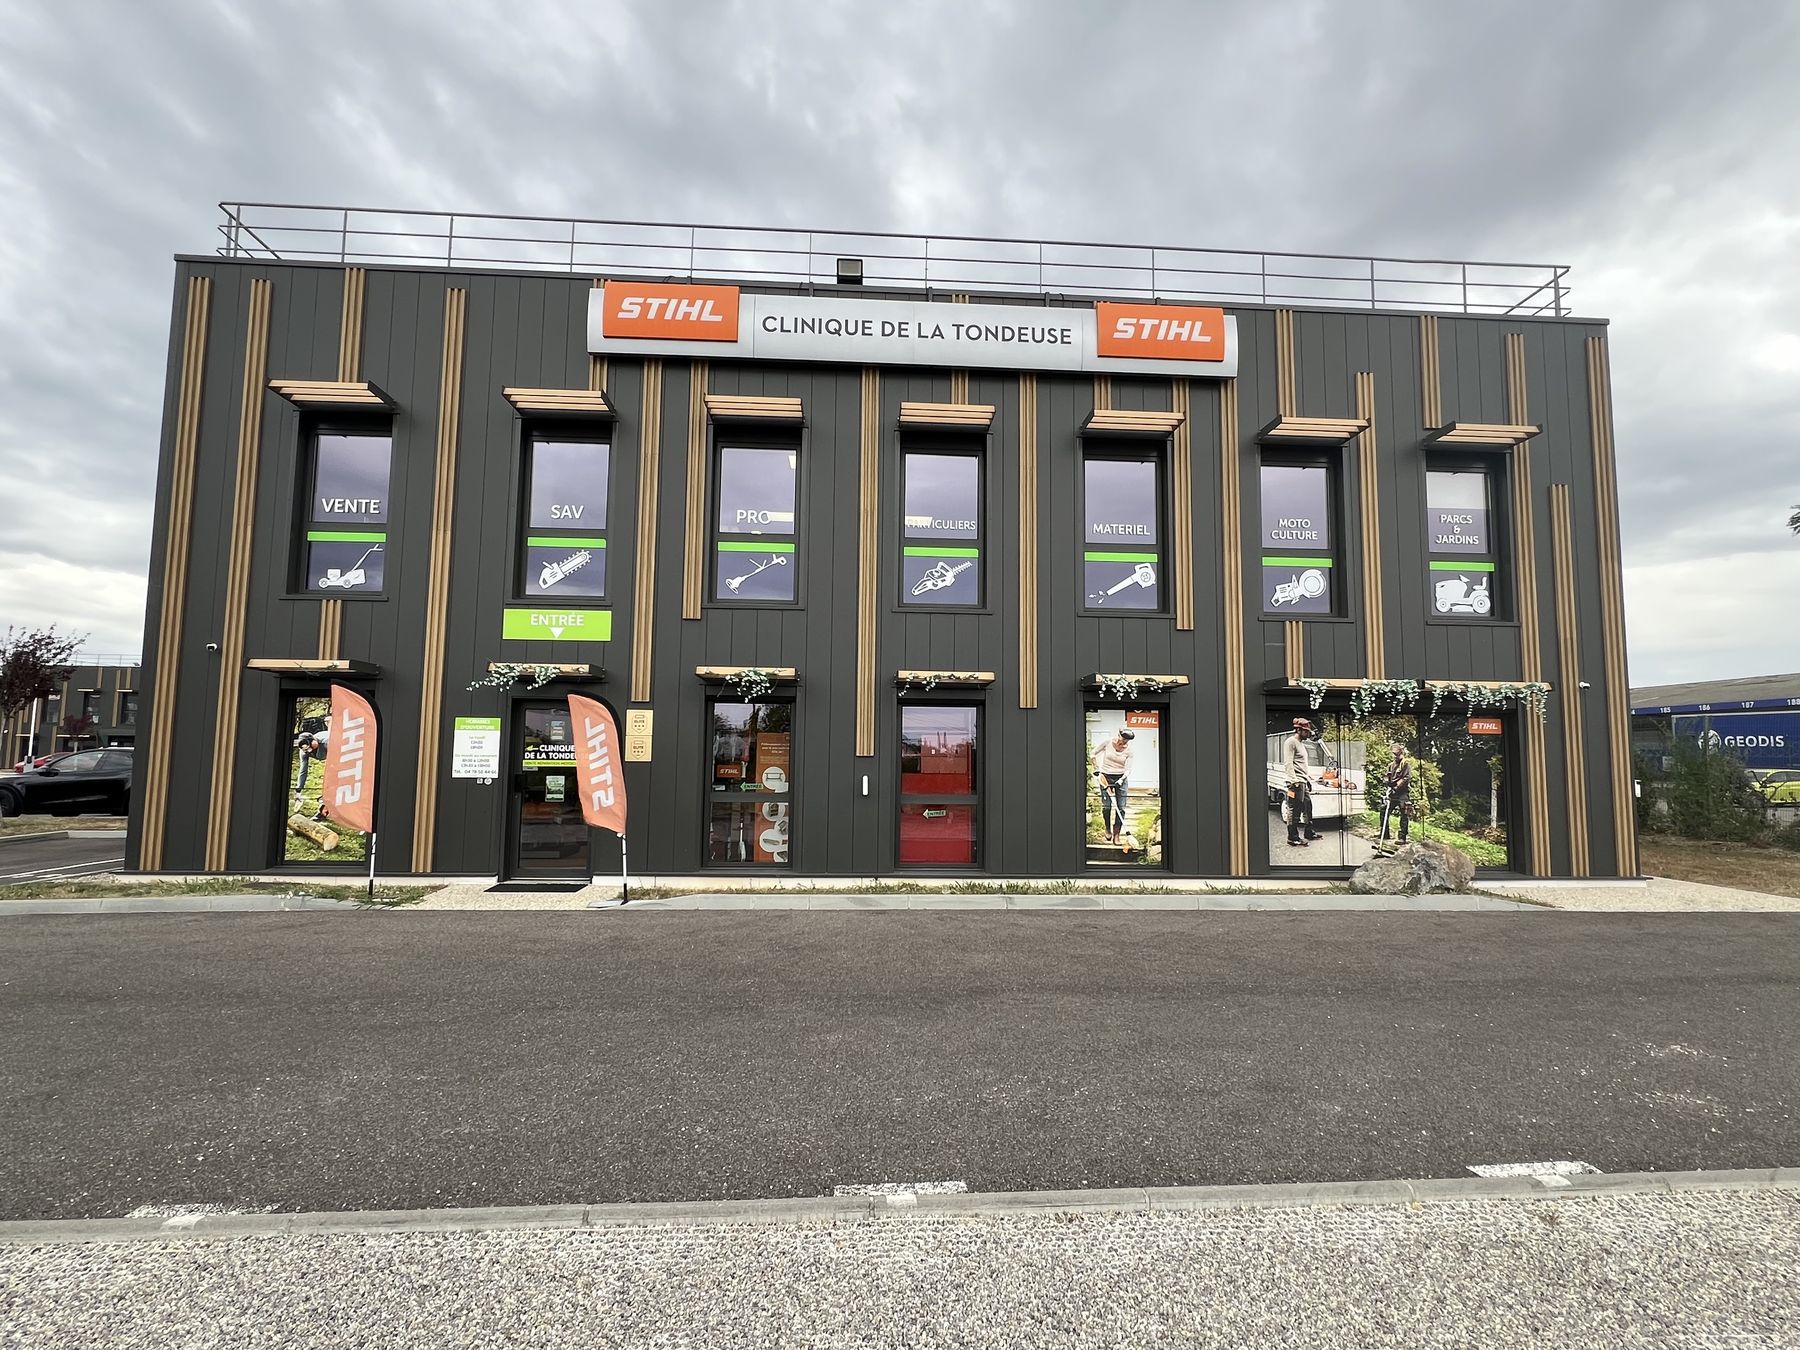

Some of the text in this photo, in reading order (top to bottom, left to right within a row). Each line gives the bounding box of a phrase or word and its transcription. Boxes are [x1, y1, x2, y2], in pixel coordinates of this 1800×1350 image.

[617, 297, 723, 322] STIHL
[762, 316, 1072, 345] CLINIQUE DE LA TONDEUSE
[1113, 317, 1212, 342] STIHL
[321, 498, 380, 514] VENTE
[550, 504, 584, 519] SAV
[736, 509, 772, 525] PRO
[1440, 514, 1473, 524] PARCS
[1279, 518, 1311, 528] MOTO
[1093, 523, 1151, 535] MATERIEL
[1453, 525, 1461, 534] &
[1271, 530, 1318, 540] CULTURE
[1435, 535, 1480, 545] JARDINS
[530, 611, 585, 626] ENTRÉE
[1130, 716, 1158, 724] STIHL
[1471, 722, 1498, 730] STIHL
[1724, 735, 1786, 747] GEODIS
[539, 744, 576, 752] CLINIQUE
[548, 752, 577, 760] TONDE
